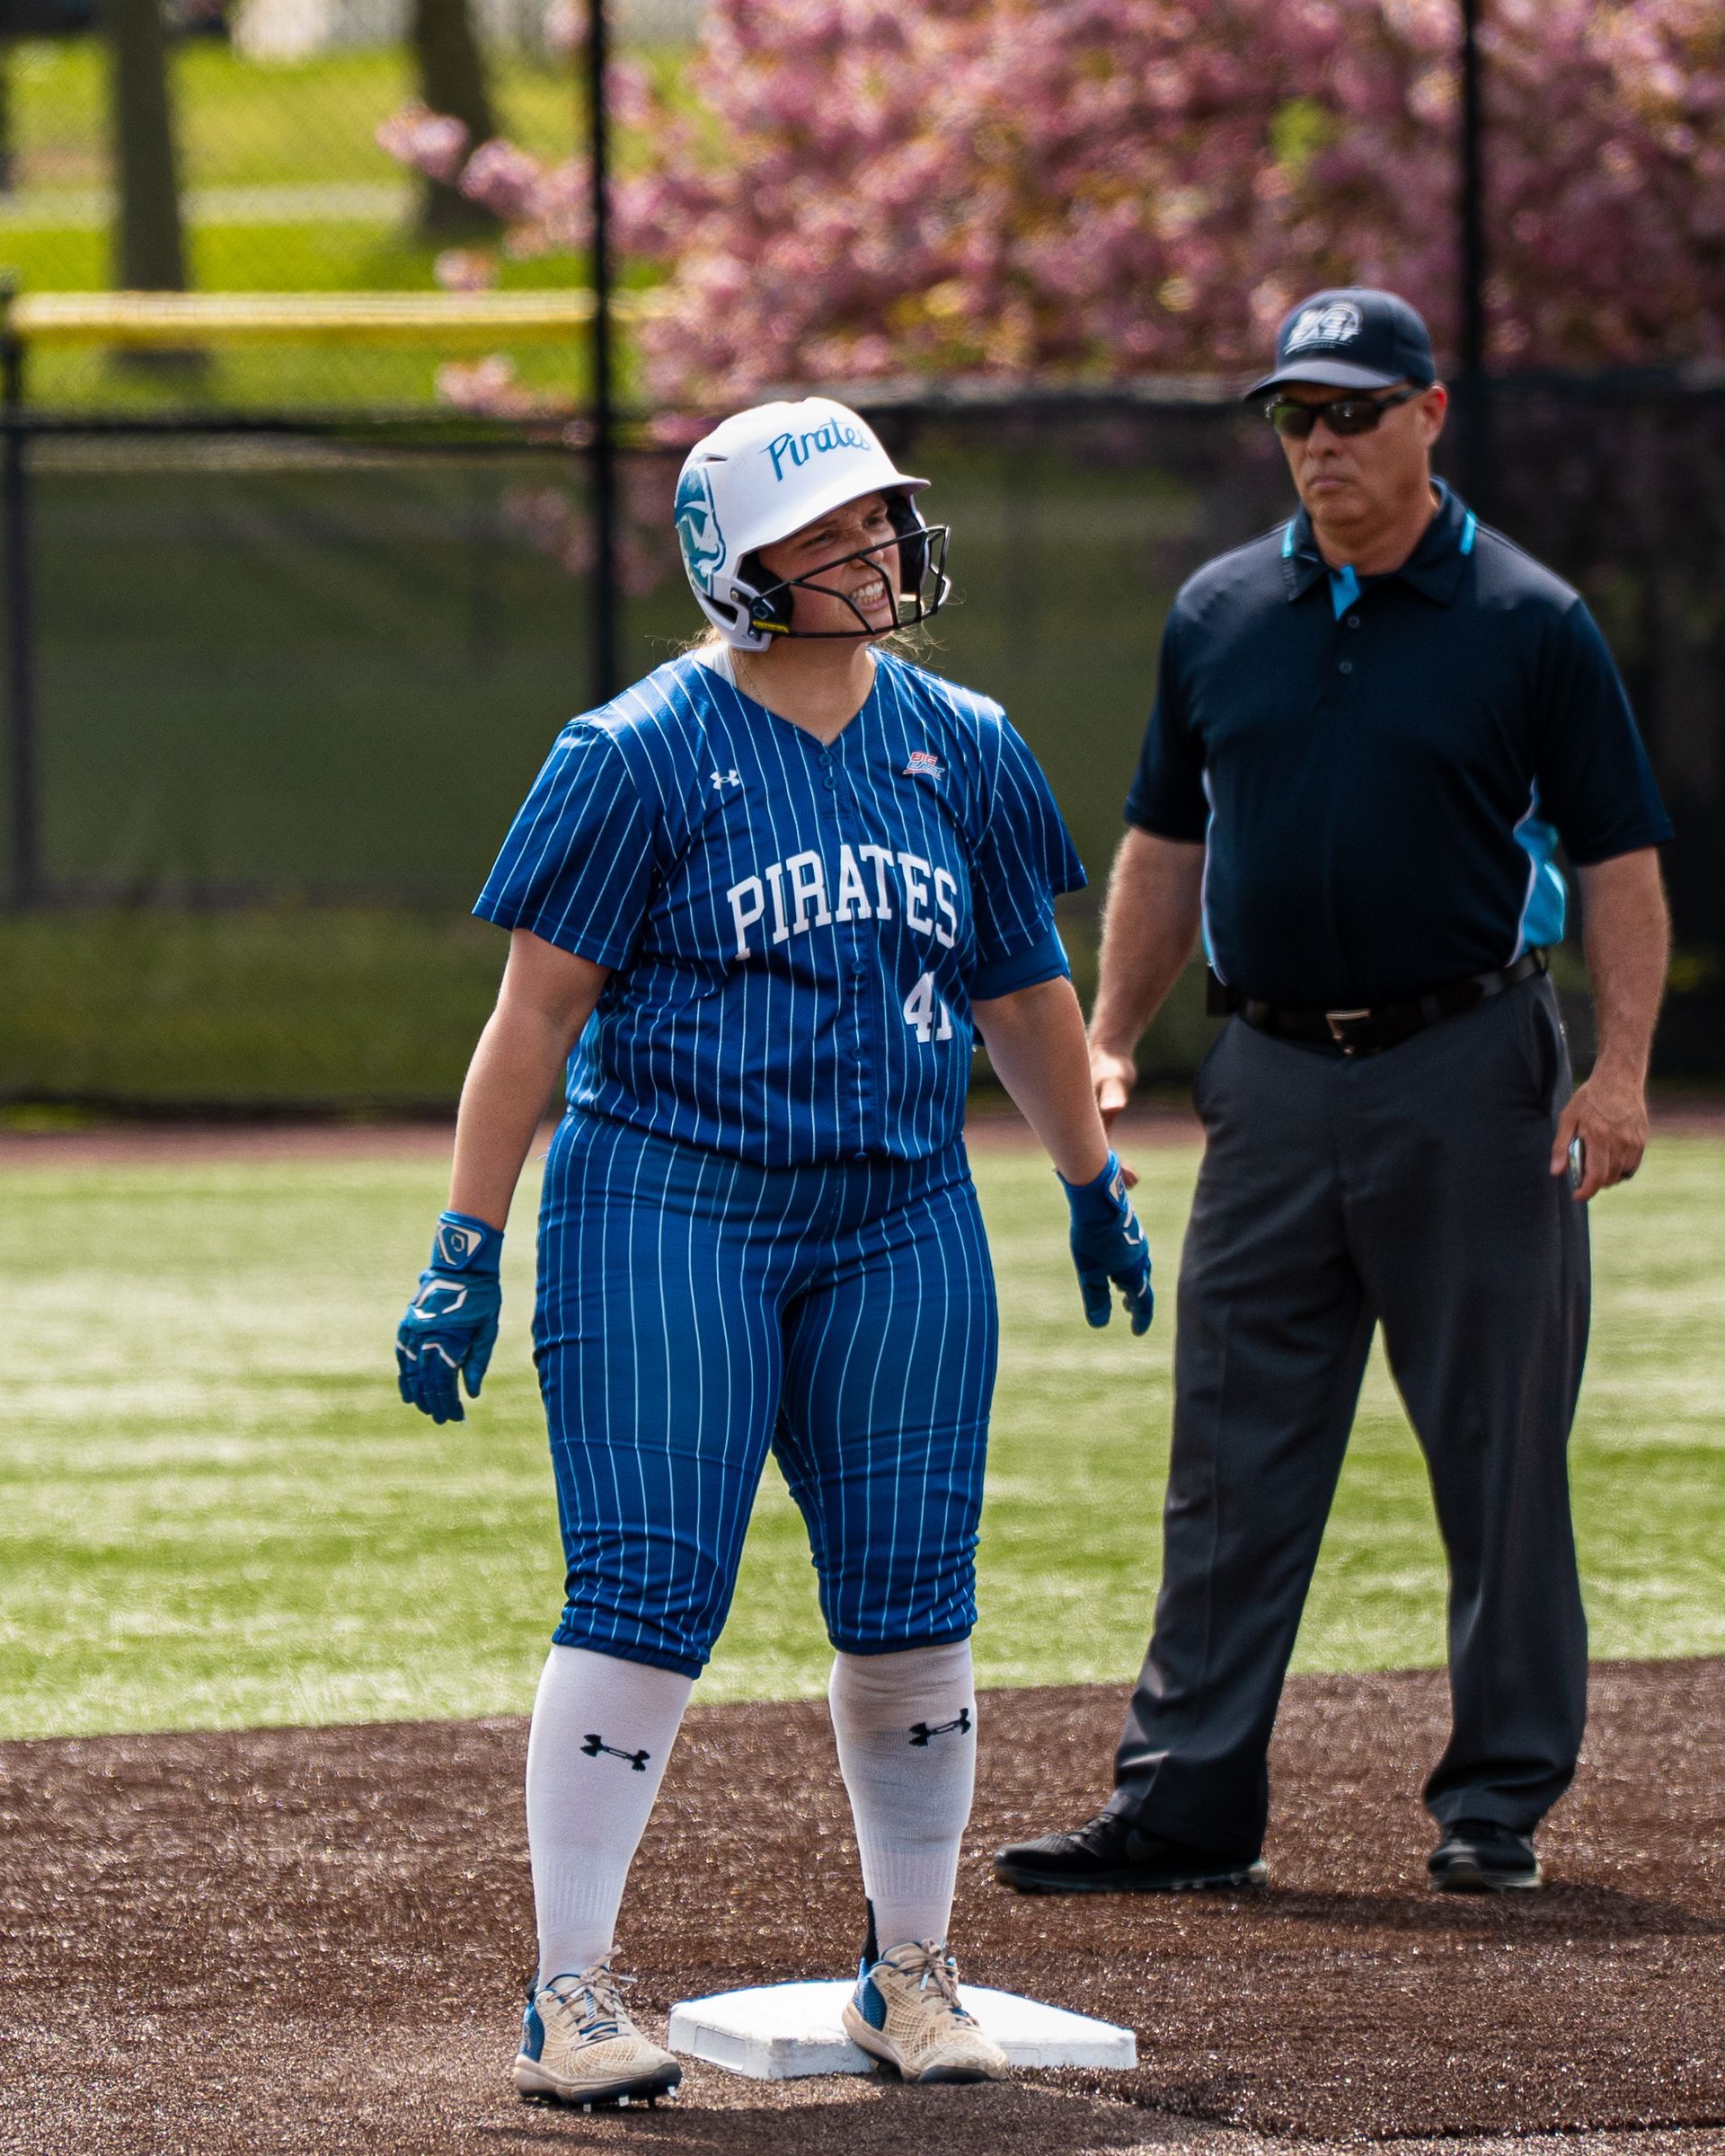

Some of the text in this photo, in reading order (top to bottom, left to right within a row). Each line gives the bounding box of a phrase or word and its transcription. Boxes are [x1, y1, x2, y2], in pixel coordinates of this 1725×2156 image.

[760, 418, 871, 482] Pirates
[907, 761, 945, 779] EAST
[909, 751, 937, 765] BIG
[727, 836, 957, 960] PIRATES
[903, 972, 952, 1042] 41
